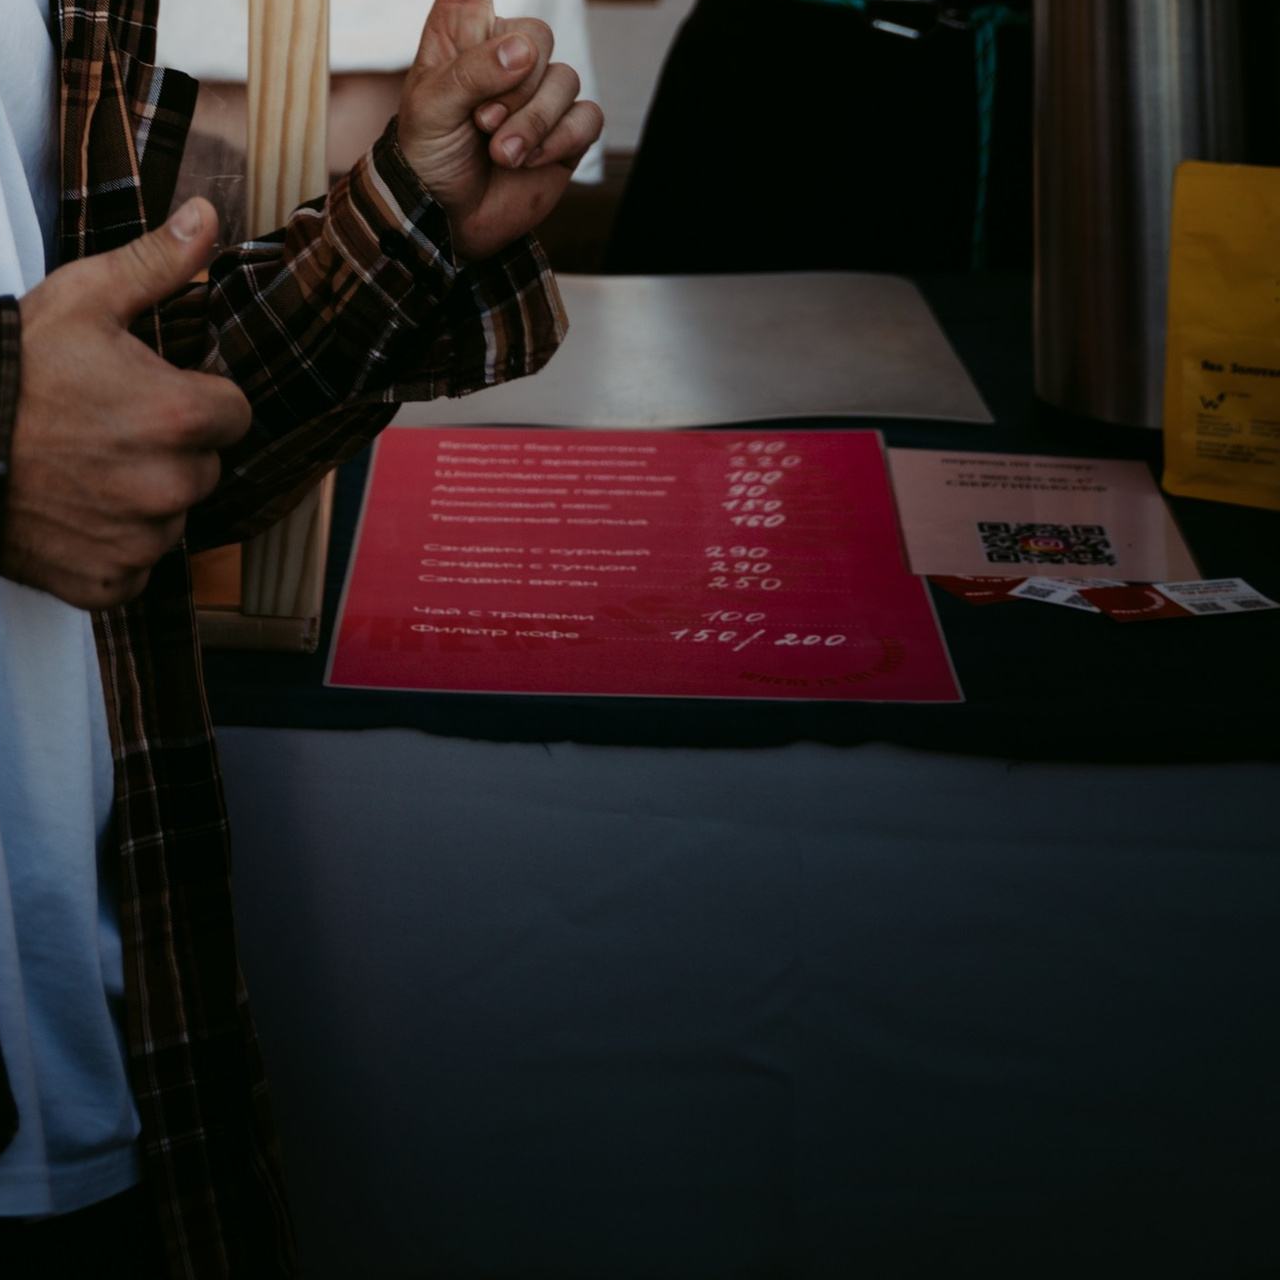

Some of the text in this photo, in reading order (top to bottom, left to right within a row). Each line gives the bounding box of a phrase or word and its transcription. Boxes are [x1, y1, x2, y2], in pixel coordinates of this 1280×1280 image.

[723, 470, 784, 484] 100
[727, 484, 767, 497] 90
[729, 514, 786, 527] 160
[422, 543, 524, 554] Сэндвич
[549, 546, 651, 557] курицей
[704, 545, 770, 558] 290
[420, 559, 523, 569] Сэндвич
[549, 563, 637, 572] тунцом
[708, 561, 774, 574] 290
[418, 575, 783, 590] Сэндвич веган 250
[412, 606, 461, 615] Чай
[488, 610, 595, 621] травами
[701, 610, 767, 623] 100
[410, 624, 508, 637] Фильтр
[515, 630, 580, 640] кофе
